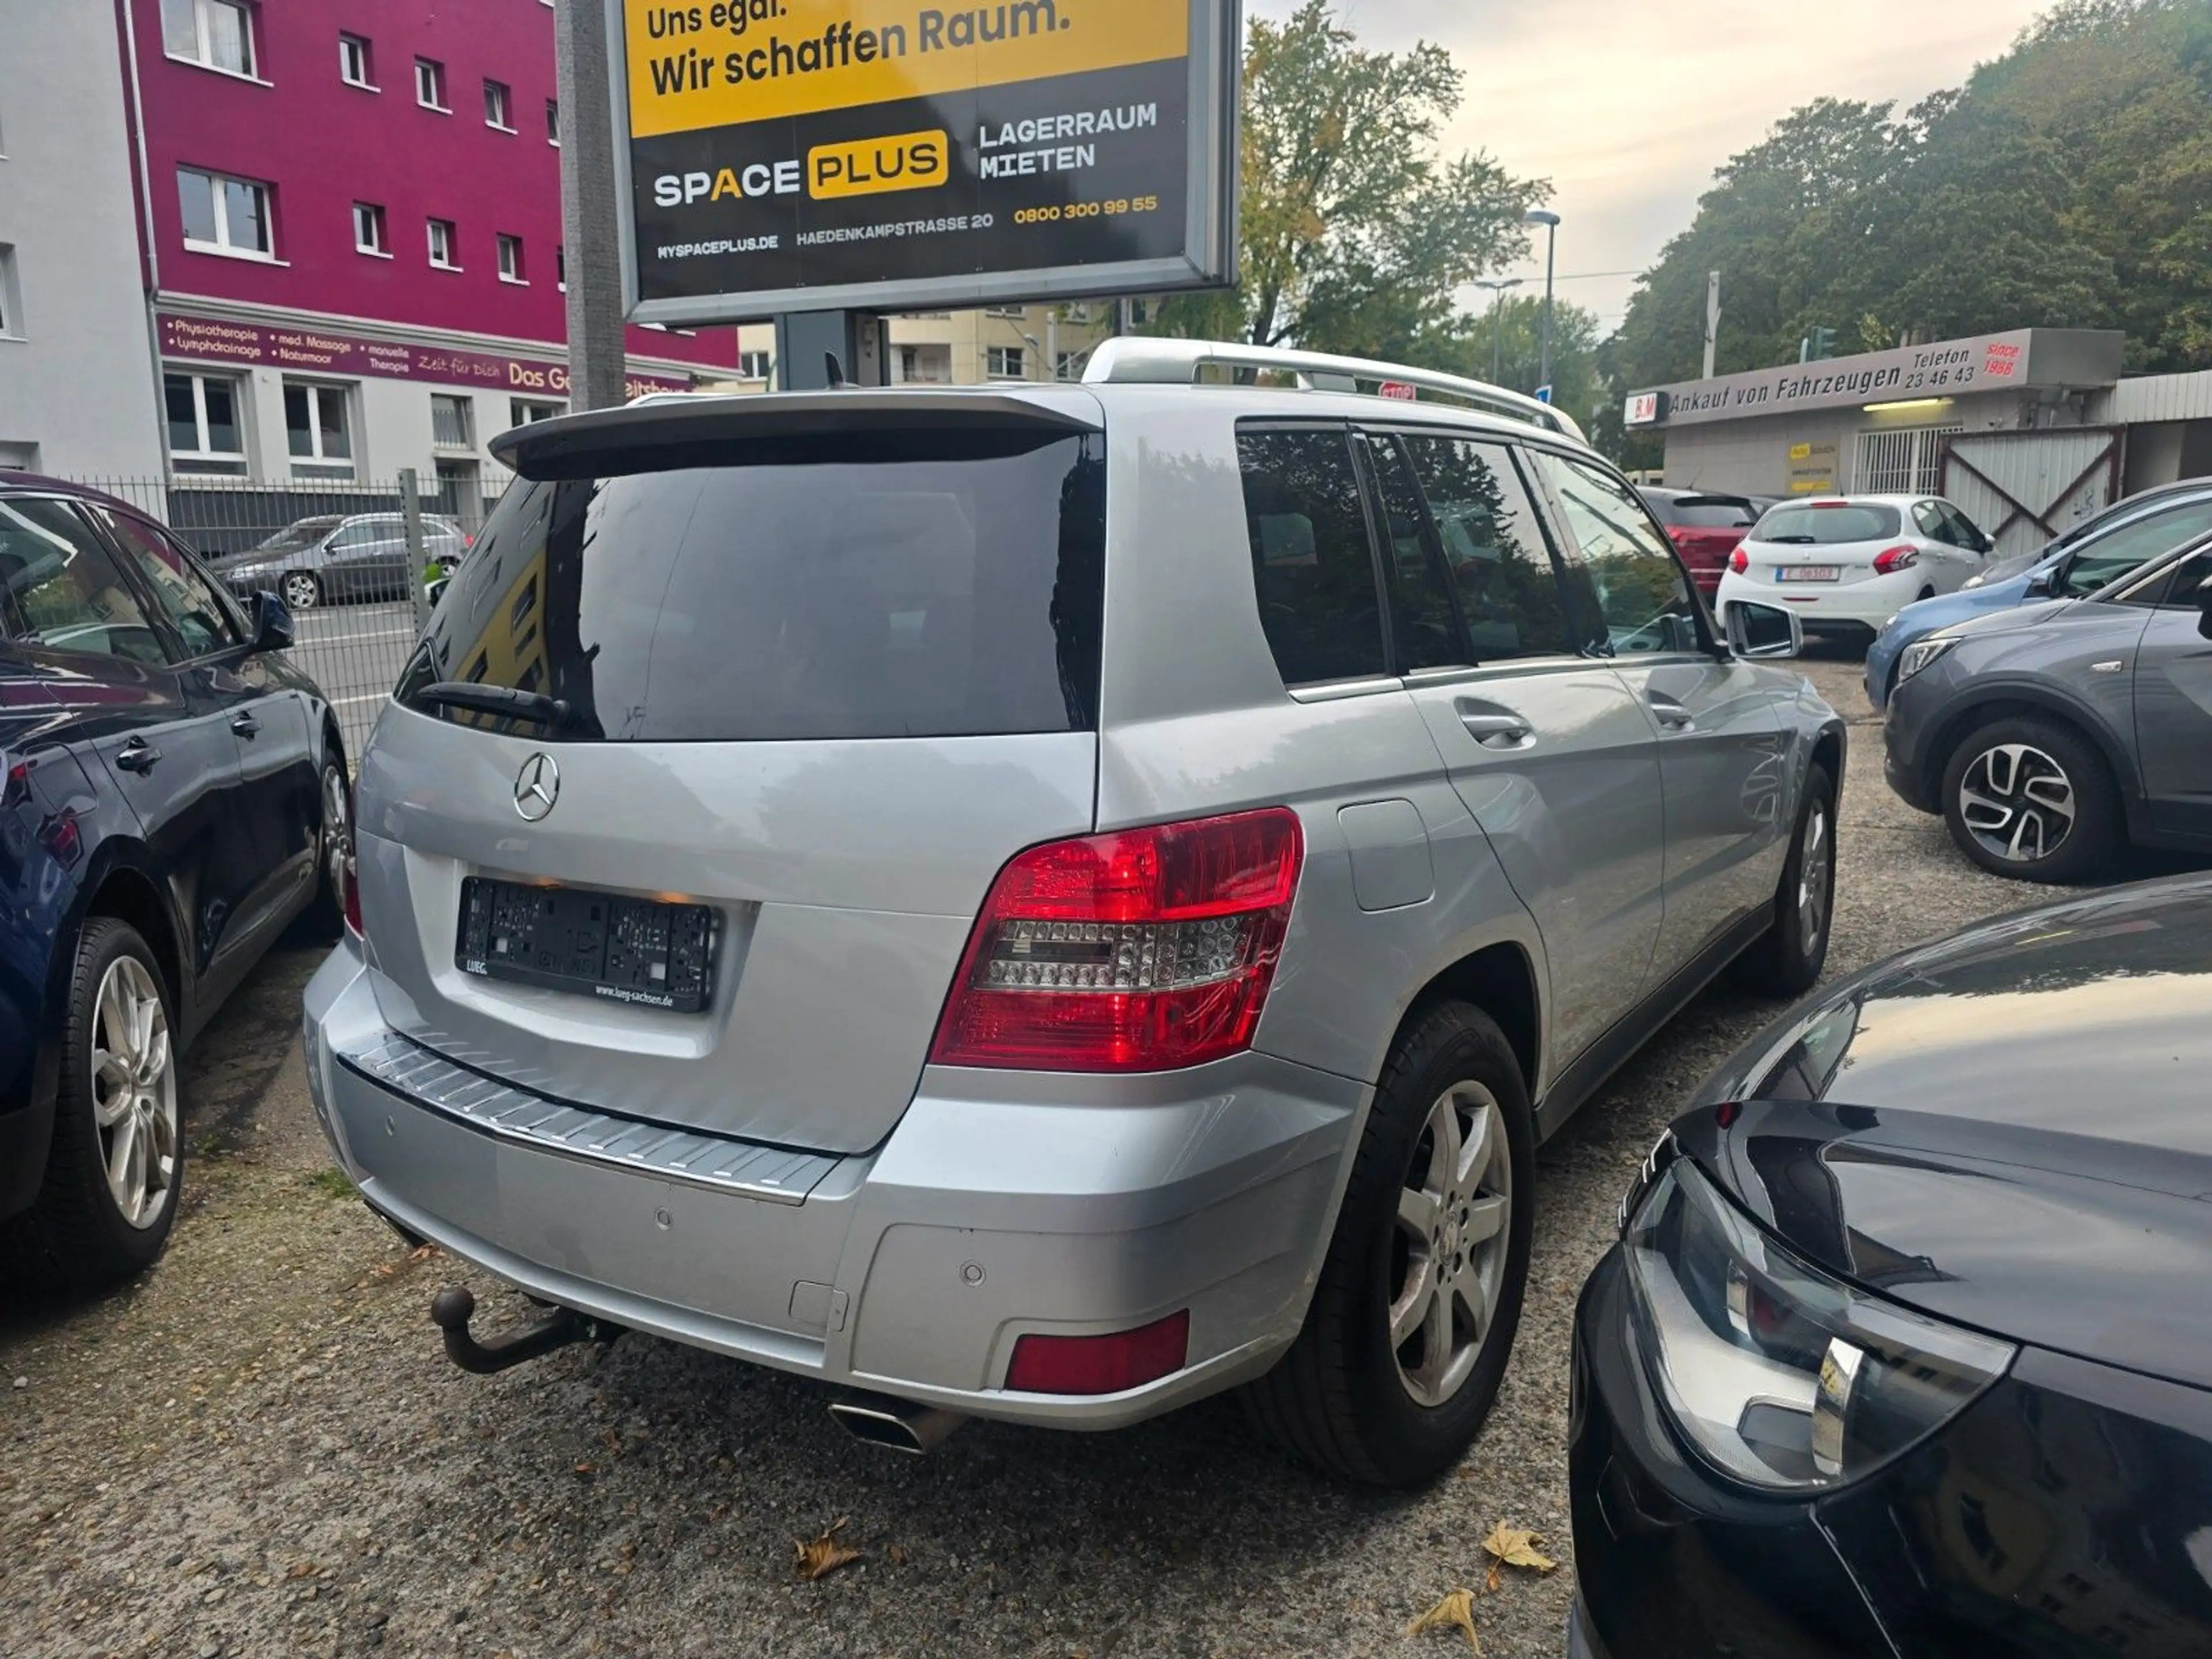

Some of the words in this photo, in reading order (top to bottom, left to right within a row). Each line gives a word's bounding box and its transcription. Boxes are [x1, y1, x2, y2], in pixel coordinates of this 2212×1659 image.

[648, 7, 702, 39] Uns
[650, 47, 714, 96] Wir
[725, 20, 906, 84] schaffen
[919, 0, 1071, 53] Raum.
[979, 103, 1157, 150] LAGERRAUM
[980, 143, 1094, 180] MIETEN
[654, 160, 801, 207] SPACE
[816, 143, 939, 187] PLUS
[657, 234, 778, 259] MYSPACEPLUS.DE
[796, 215, 968, 245] HAEDENKAMPSTRASSE
[971, 213, 994, 229] 20
[1014, 206, 1060, 224] 0800
[1064, 202, 1100, 219] 300
[1103, 198, 1128, 215] 99
[1132, 195, 1158, 212] 55
[175, 319, 259, 342] Physiotherapie
[177, 337, 261, 359] Lymphdrainage
[278, 334, 303, 347] med.
[306, 336, 351, 353] Massage
[368, 346, 410, 359] manuelle
[1986, 342, 2021, 357] since
[279, 347, 332, 365] Naturmoor
[369, 358, 410, 374] Therapie
[417, 355, 448, 370] Zeit
[450, 357, 470, 377] für
[1914, 348, 1969, 369] Telefon
[509, 362, 546, 388] Das
[1905, 373, 1923, 389] 23
[1930, 369, 1948, 385] 46
[1955, 366, 1974, 383] 43
[1669, 386, 1730, 415] Ankauf
[1737, 385, 1769, 404] von
[1776, 366, 1901, 399] Fahrzeugen
[595, 979, 673, 1007] www.lueg-sachsen.de
